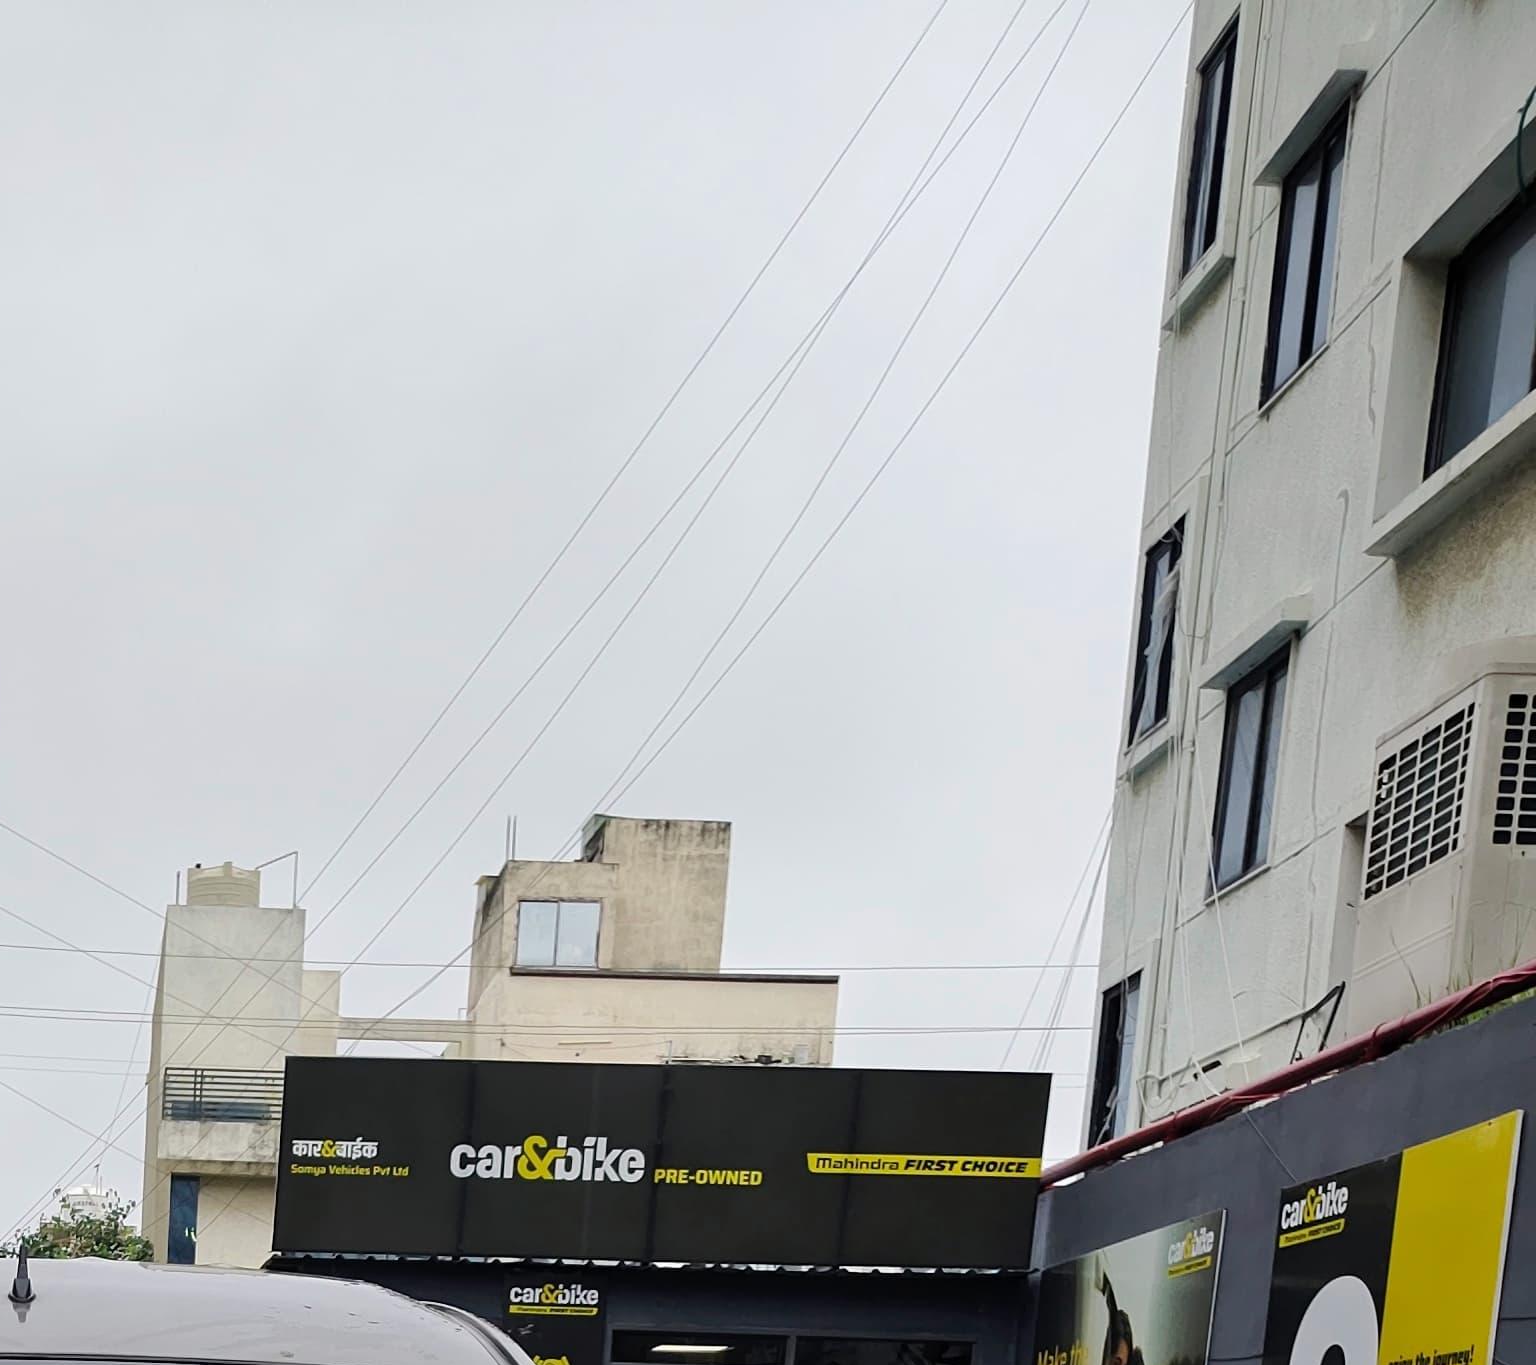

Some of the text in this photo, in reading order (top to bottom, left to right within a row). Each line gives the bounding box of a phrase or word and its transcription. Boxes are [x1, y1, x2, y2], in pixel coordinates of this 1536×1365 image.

[329, 1164, 371, 1176] Vehicles
[372, 1165, 390, 1176] Pvt
[392, 1165, 409, 1177] Ltd
[450, 1135, 763, 1186] car&bike PRE-OWNED
[816, 1157, 1029, 1174] Mahindra FIRST CHOICE
[1281, 1181, 1349, 1230] car&bike
[509, 1283, 599, 1305] car&bike
